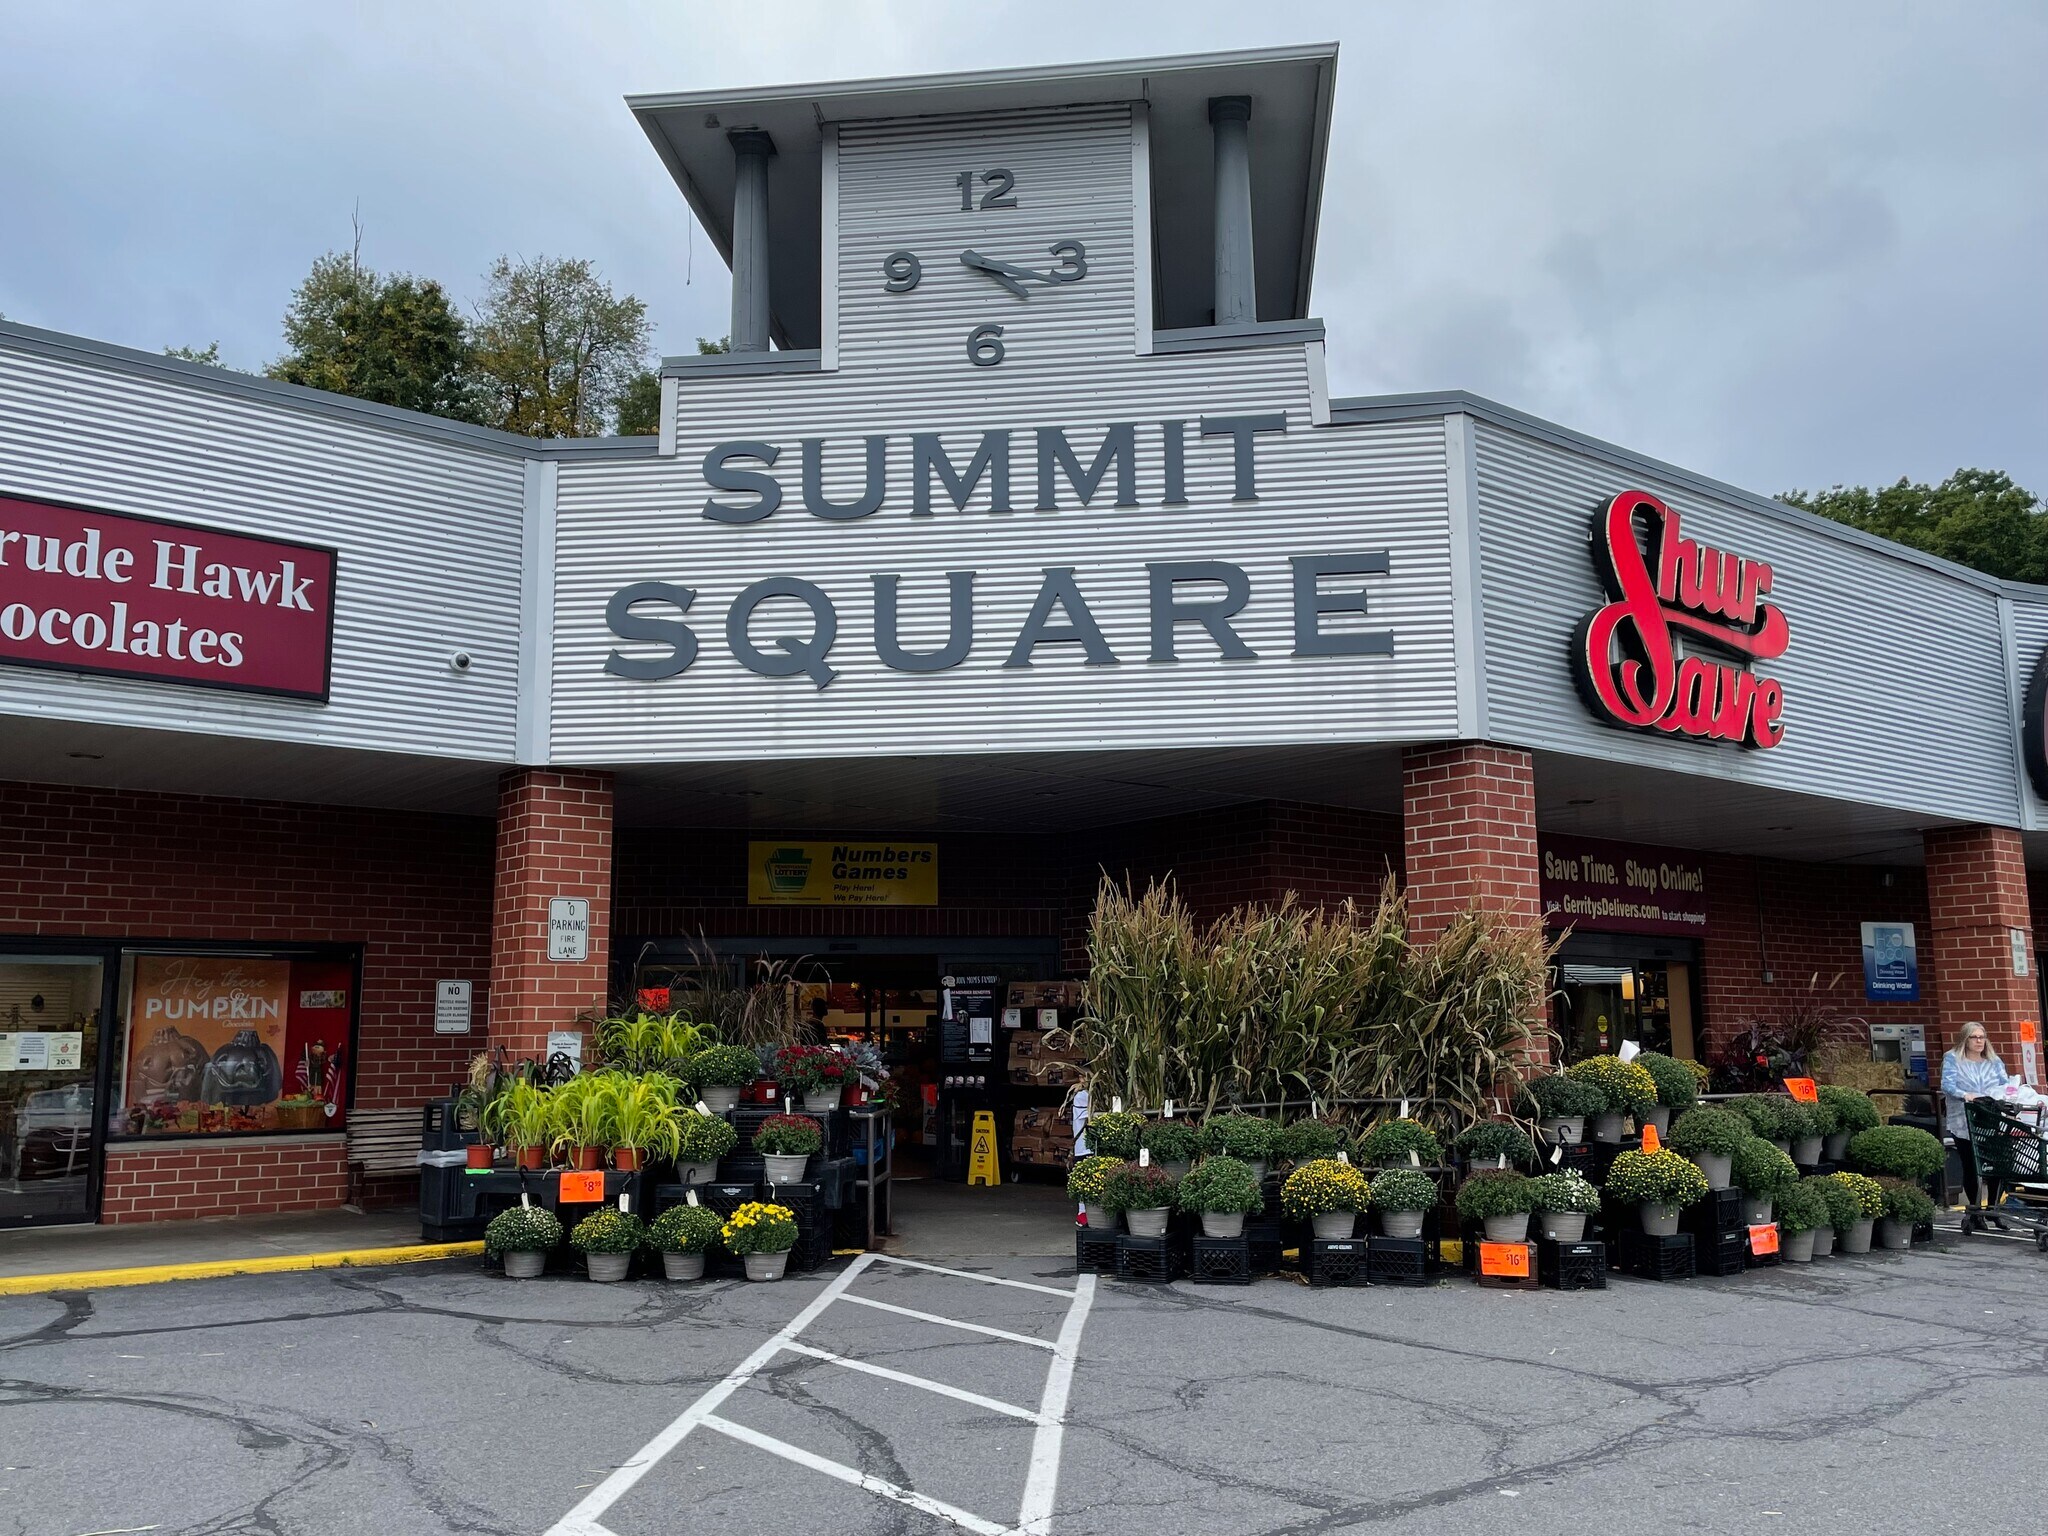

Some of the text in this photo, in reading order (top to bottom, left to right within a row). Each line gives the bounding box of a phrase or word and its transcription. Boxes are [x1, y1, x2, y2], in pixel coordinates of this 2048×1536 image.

[956, 168, 1018, 211] 12
[883, 240, 1088, 292] 9 3
[966, 324, 1005, 366] 6
[702, 410, 1287, 525] SUMMIT
[149, 540, 315, 612] Hawk
[603, 549, 1395, 691] SQUARE
[0, 601, 244, 668] ocolates
[831, 846, 933, 863] Numbers
[831, 862, 909, 880] Games
[1545, 851, 1703, 895] Save Time. Shop Online!
[833, 883, 875, 893] Play Here!
[849, 894, 862, 903] Pay
[1563, 894, 1661, 920] GerritysDelivers.com
[1662, 910, 1668, 920] to
[1669, 911, 1682, 922] start
[1683, 912, 1706, 925] shopping!
[551, 919, 586, 932] PARKING
[558, 946, 577, 955] LANE
[560, 935, 576, 944] FIRE
[160, 959, 268, 1000] Hey there
[448, 986, 460, 995] NO
[1872, 981, 1895, 991] Drinking
[146, 998, 279, 1020] PUMPKIN
